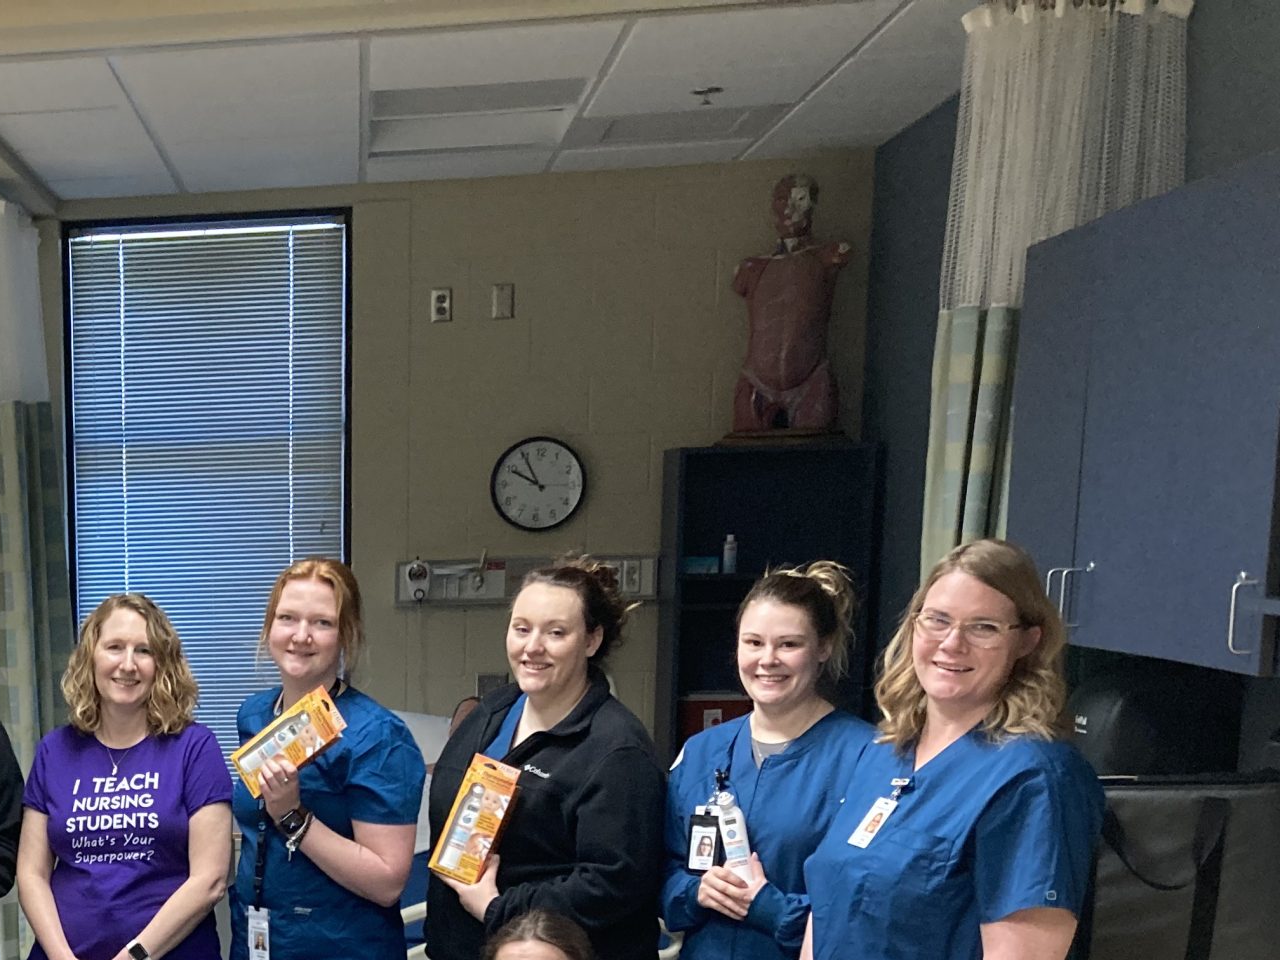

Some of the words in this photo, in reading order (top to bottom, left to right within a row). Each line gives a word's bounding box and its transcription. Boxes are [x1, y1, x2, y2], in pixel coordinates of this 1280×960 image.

[73, 779, 80, 795] I
[92, 771, 159, 793] TEACH
[72, 793, 154, 812] NURSING
[66, 812, 159, 833] STUDENTS
[72, 835, 116, 849] What's
[123, 833, 155, 846] Your
[74, 850, 155, 865] Superpower?
